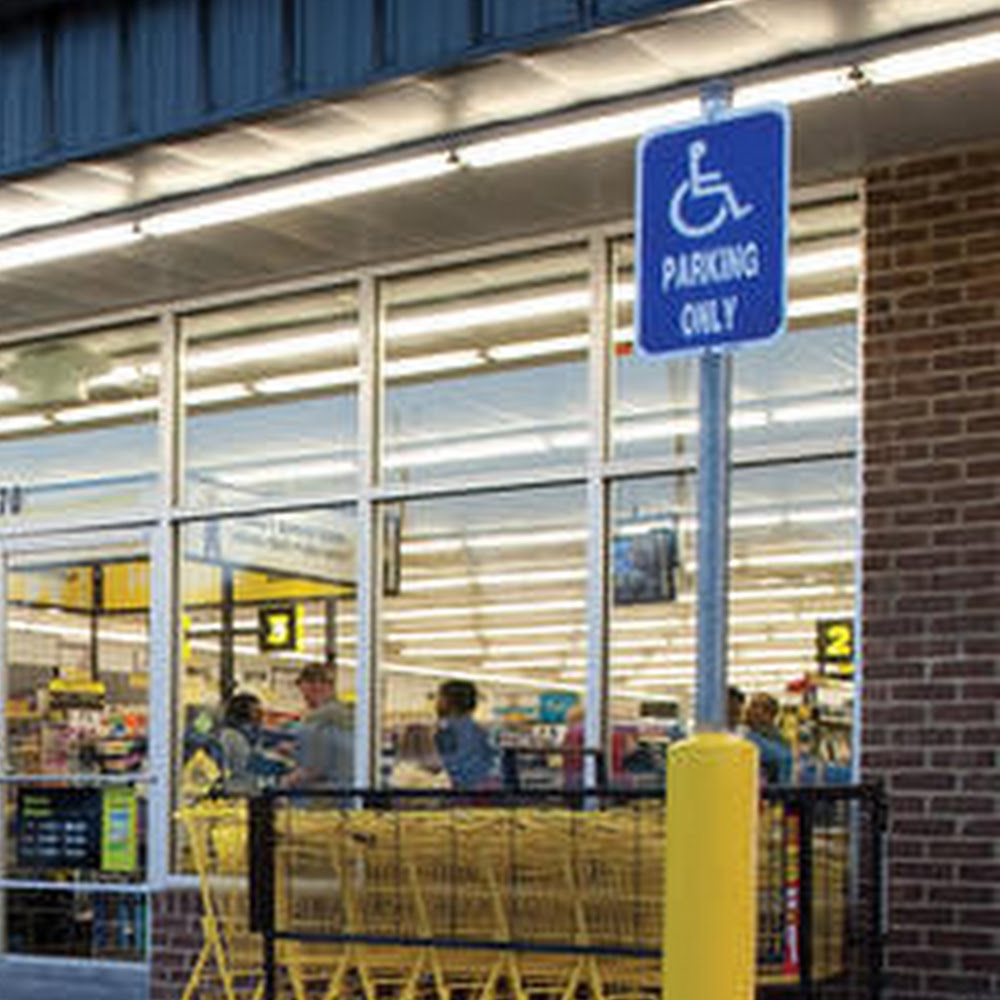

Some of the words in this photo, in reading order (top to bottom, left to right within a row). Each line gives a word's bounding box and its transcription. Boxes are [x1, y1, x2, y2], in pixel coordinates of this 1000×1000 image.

[661, 241, 760, 292] PARKING
[680, 296, 739, 335] ONLY
[826, 625, 851, 656] 2
